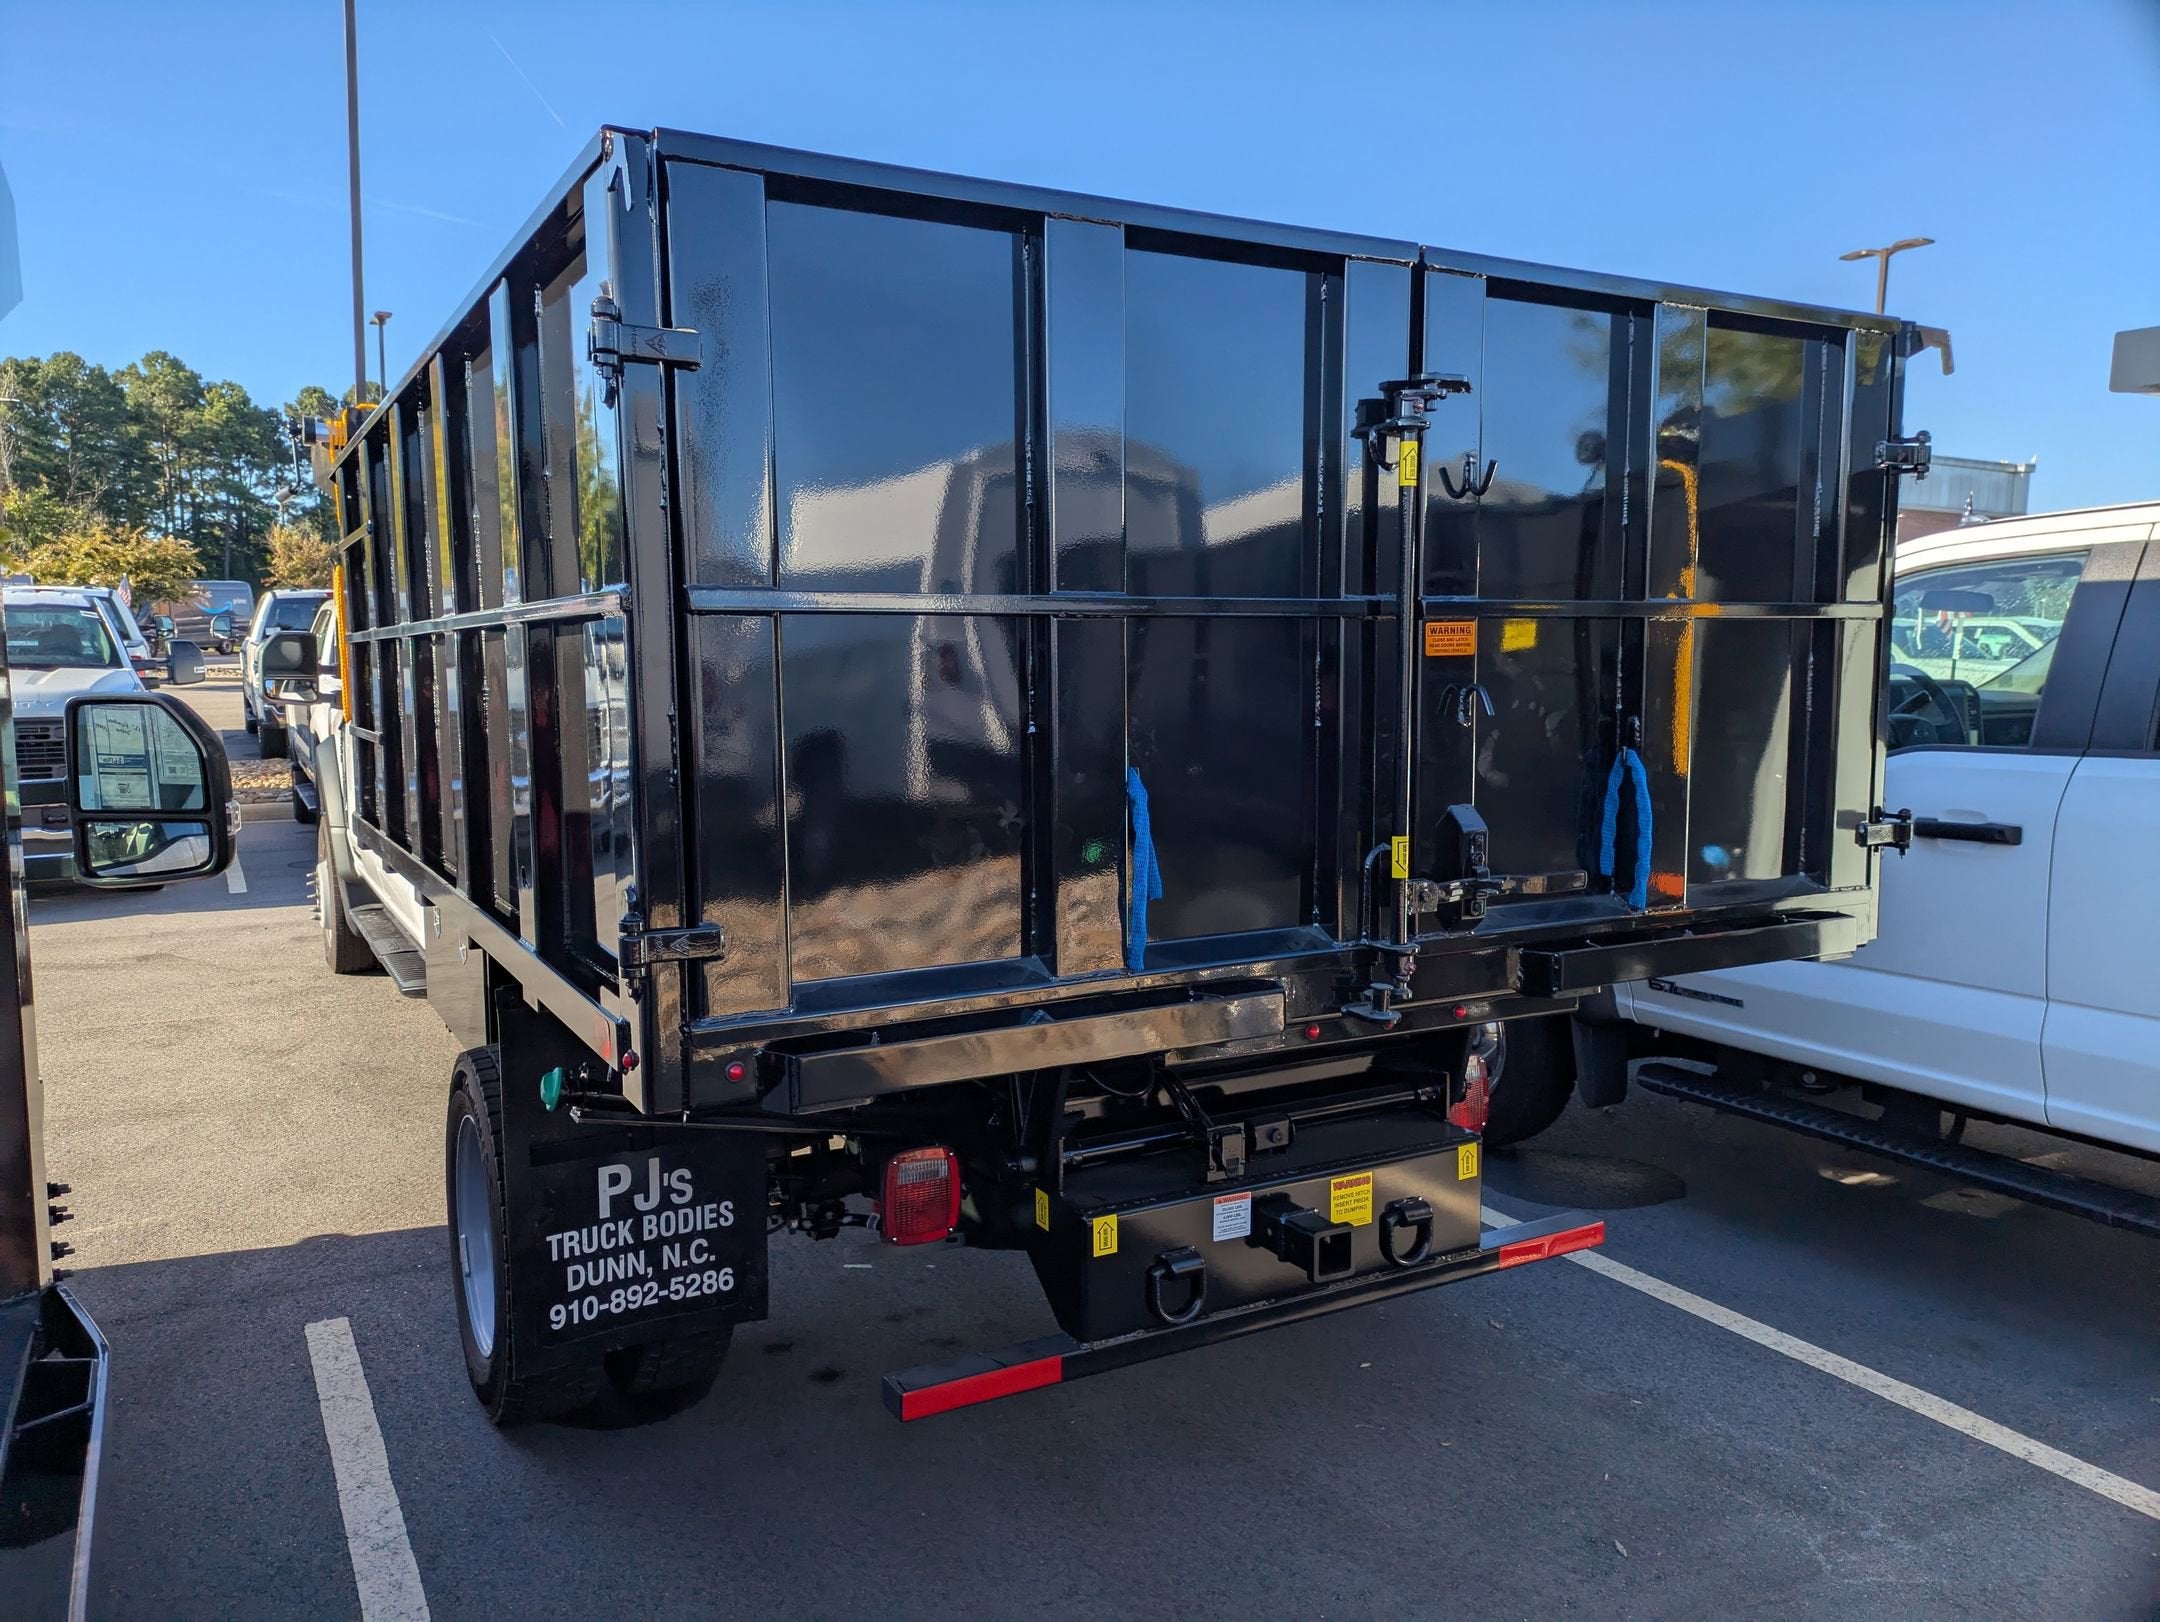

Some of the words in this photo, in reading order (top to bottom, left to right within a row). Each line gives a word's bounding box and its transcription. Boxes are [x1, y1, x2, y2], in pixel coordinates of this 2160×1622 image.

[1429, 626, 1471, 635] WARNING
[1333, 1175, 1371, 1191] WARNING
[1222, 1193, 1249, 1203] WARNING
[1333, 1191, 1354, 1201] REMOVE
[1355, 1189, 1370, 1197] HITCH
[1334, 1199, 1352, 1208] INSERT
[1353, 1196, 1369, 1205] PRIOR
[1344, 1203, 1367, 1214] DUMPING
[546, 1218, 635, 1262] TRUCK
[642, 1200, 734, 1241] BODIES
[567, 1250, 653, 1292] DUNN,
[662, 1238, 716, 1270] N.C.
[550, 1267, 734, 1330] 910-892-5286
